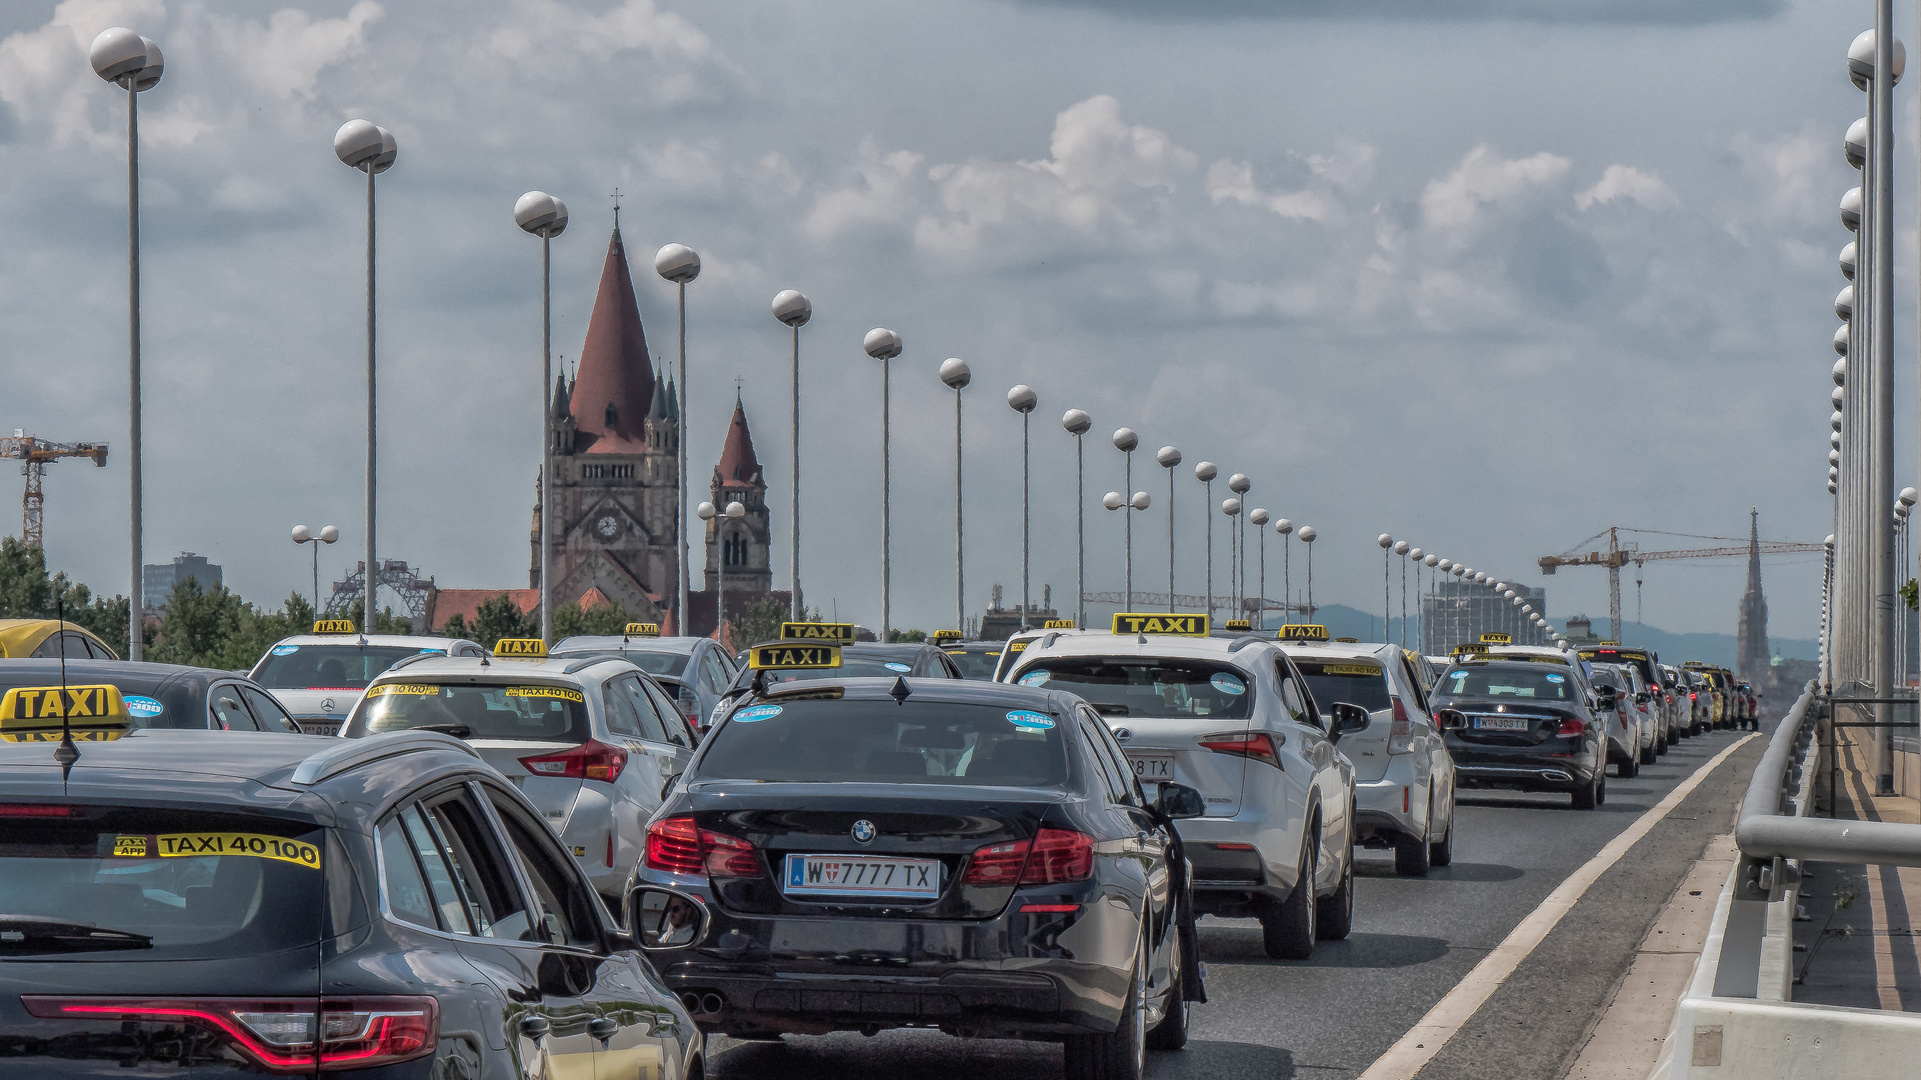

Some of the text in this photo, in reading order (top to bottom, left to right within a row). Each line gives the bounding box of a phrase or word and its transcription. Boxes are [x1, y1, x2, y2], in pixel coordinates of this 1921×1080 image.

[321, 621, 348, 631] TAXI
[630, 624, 657, 633] TAXI
[1051, 620, 1071, 628] TAXI
[1125, 618, 1195, 632] TAXI
[790, 626, 843, 638] TAXI
[1287, 627, 1320, 637] TAXI
[503, 640, 539, 653] TAXI
[768, 650, 822, 665] TAXI
[1354, 667, 1380, 675] 40100
[523, 687, 581, 700] TAXI 40100
[20, 689, 104, 717] TAXI
[126, 701, 161, 713] 1300
[1009, 715, 1053, 726] 31300
[1150, 760, 1168, 775] TX
[115, 838, 146, 847] TAXI
[120, 847, 145, 856] APP
[160, 837, 316, 864] TAXI 40100
[807, 861, 930, 887] W 7777 TX
